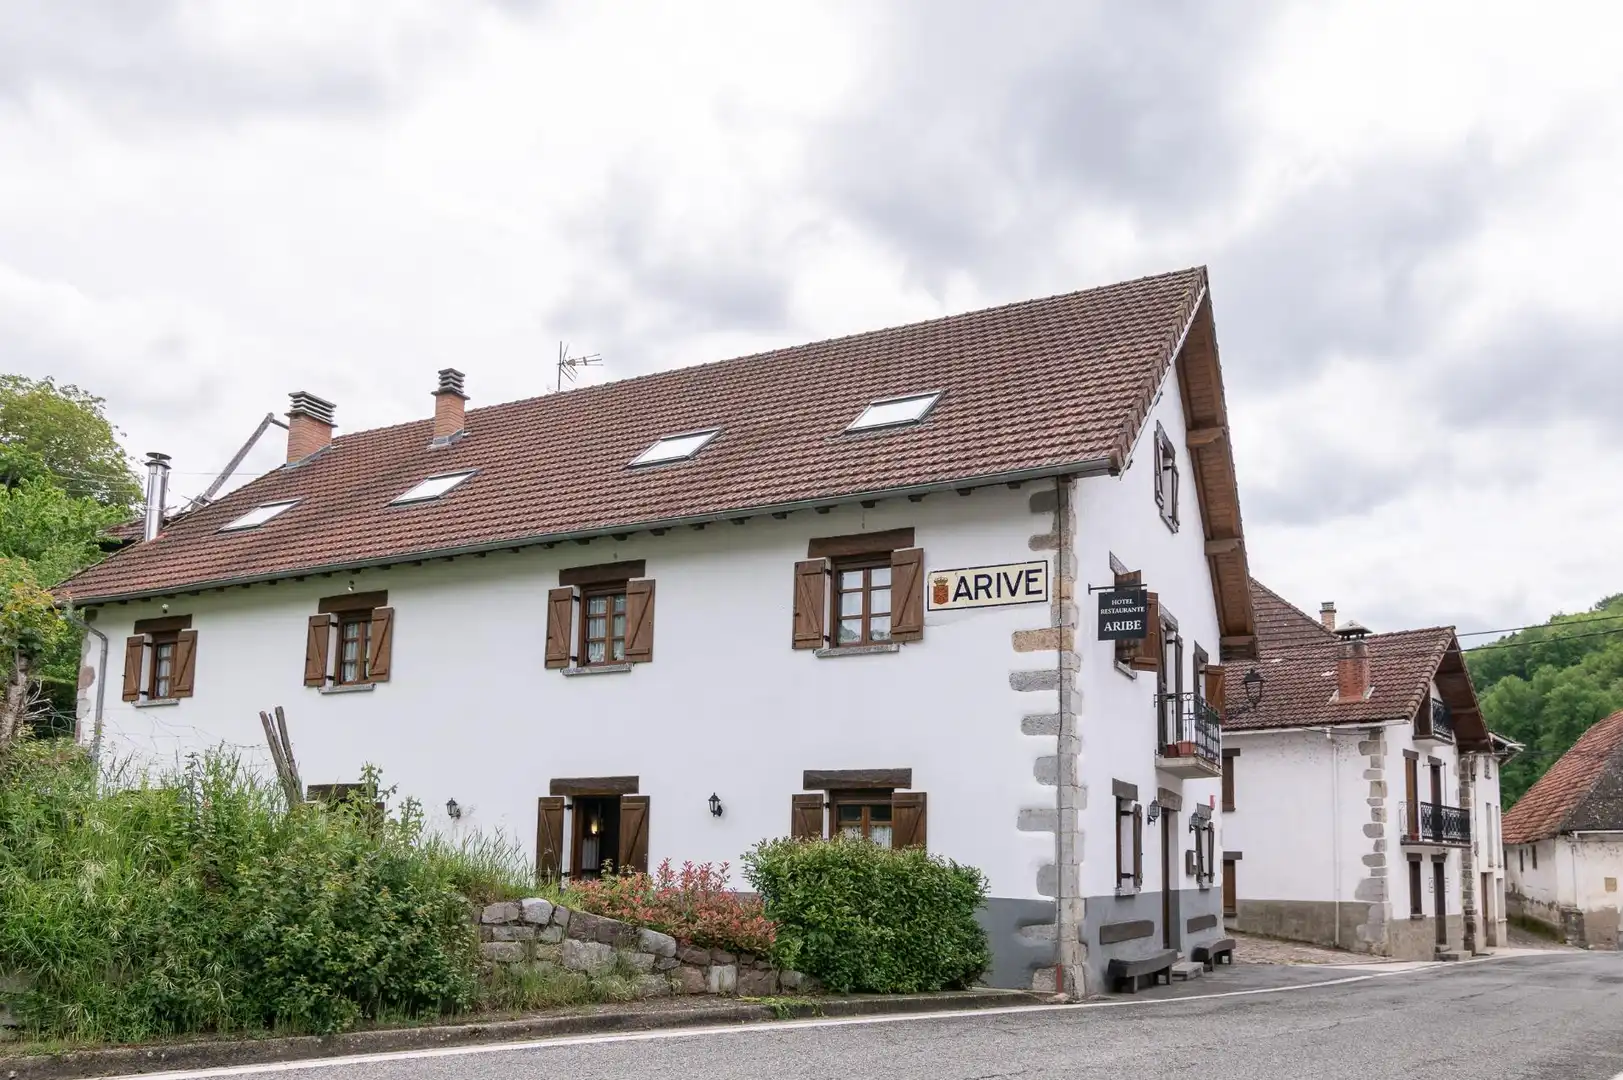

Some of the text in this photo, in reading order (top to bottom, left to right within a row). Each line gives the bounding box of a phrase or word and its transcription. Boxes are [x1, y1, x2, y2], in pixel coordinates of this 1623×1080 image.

[952, 568, 1043, 602] ARIVE
[1111, 598, 1134, 606] HOTEL
[1100, 606, 1145, 615] RESTAURANTE
[1104, 620, 1142, 632] ARIBE
